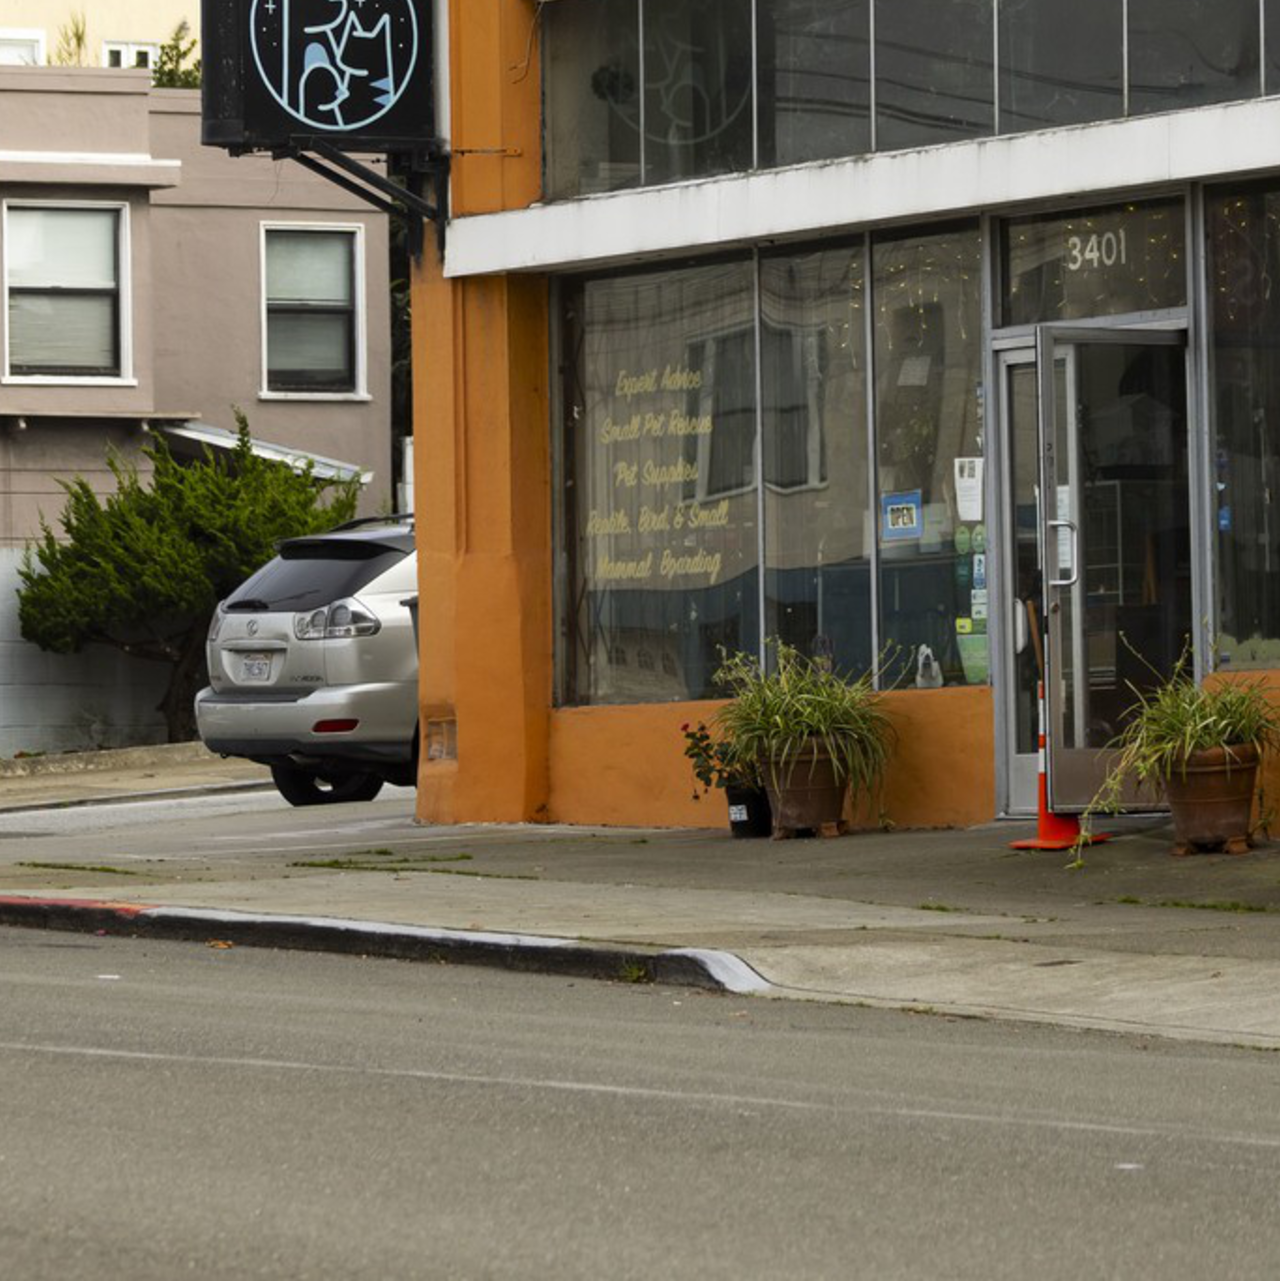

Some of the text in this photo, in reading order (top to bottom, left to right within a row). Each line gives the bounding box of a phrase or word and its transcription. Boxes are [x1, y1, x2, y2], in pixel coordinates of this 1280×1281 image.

[1067, 228, 1127, 271] 3401
[615, 363, 701, 403] Expert Advice
[598, 409, 713, 444] Small Pet Rescue
[613, 455, 699, 492] Pet Supplies
[673, 502, 685, 529] &
[687, 498, 729, 529] Small
[659, 548, 721, 586] Boarding
